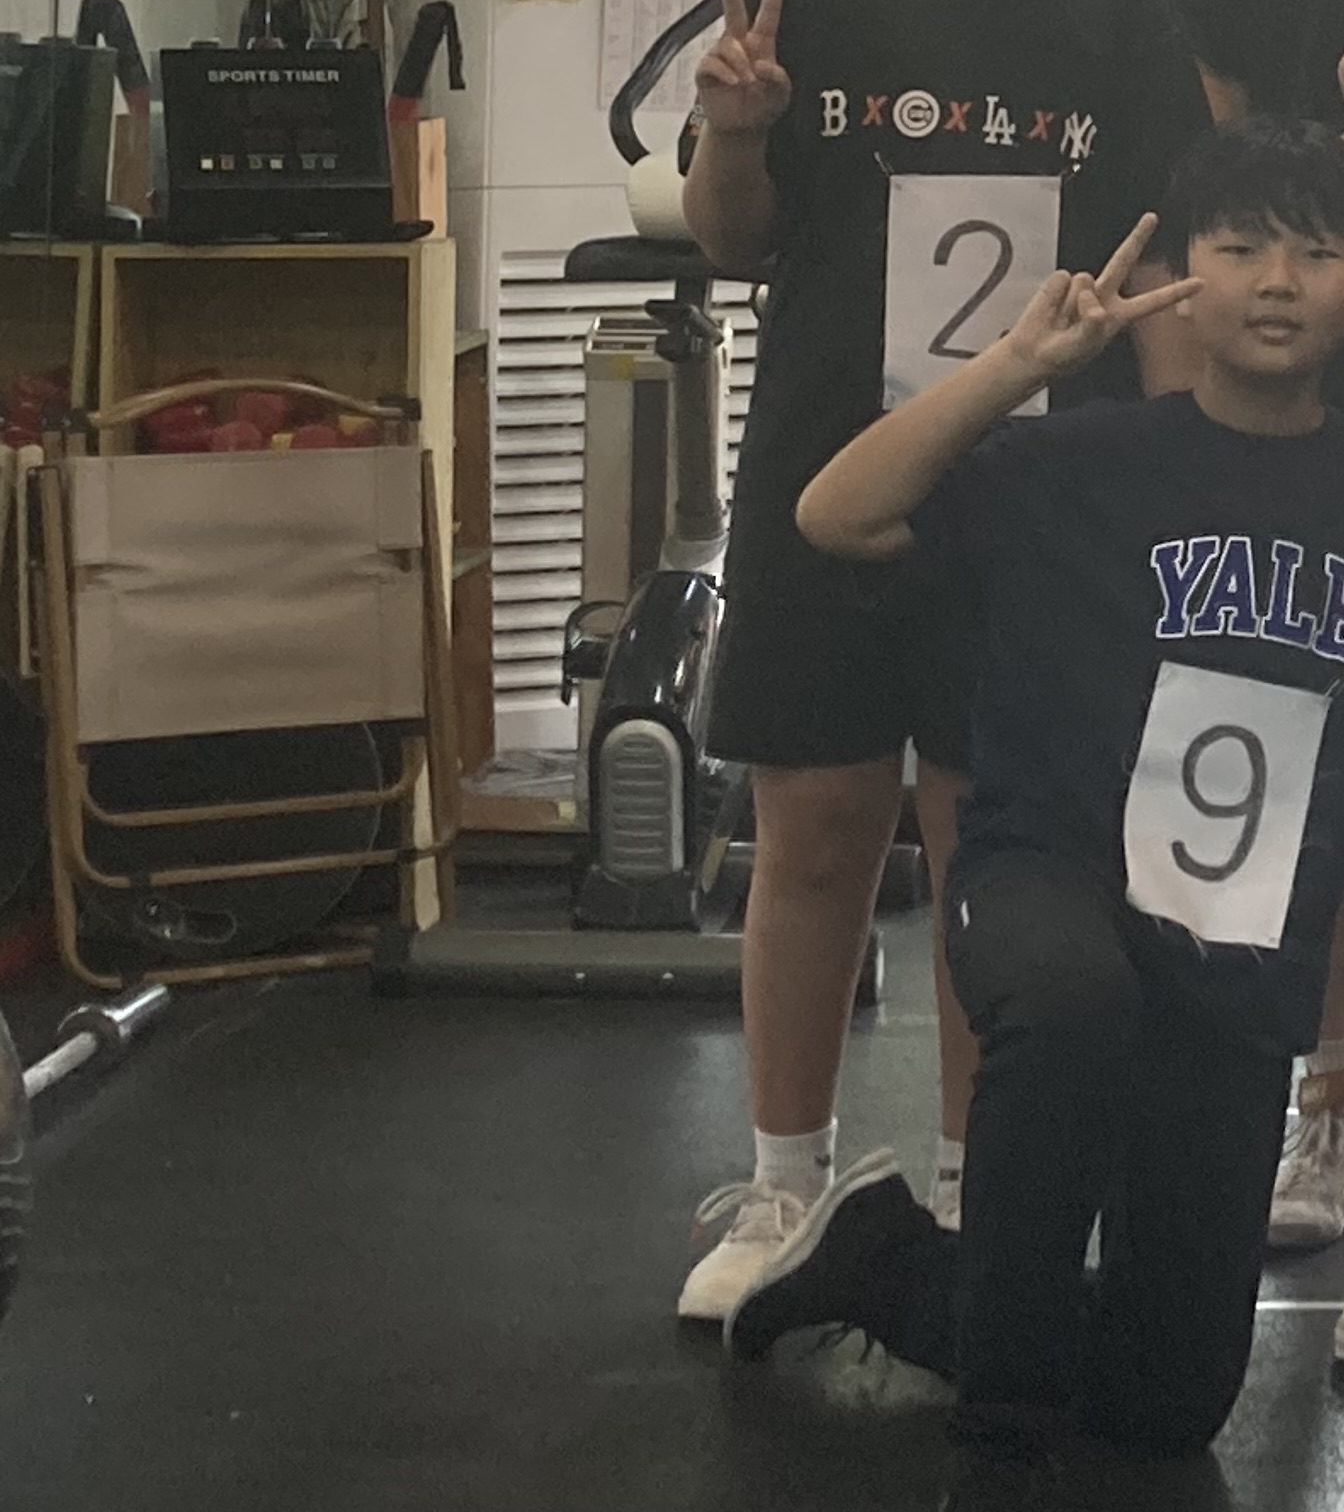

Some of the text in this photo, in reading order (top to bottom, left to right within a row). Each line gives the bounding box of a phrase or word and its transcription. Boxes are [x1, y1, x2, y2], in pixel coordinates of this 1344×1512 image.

[208, 70, 340, 83] SPORTS TIMER
[820, 89, 848, 136] B
[982, 95, 1016, 145] LA
[1060, 112, 1097, 159] NY
[928, 219, 1013, 359] 2
[1171, 724, 1267, 883] 9
